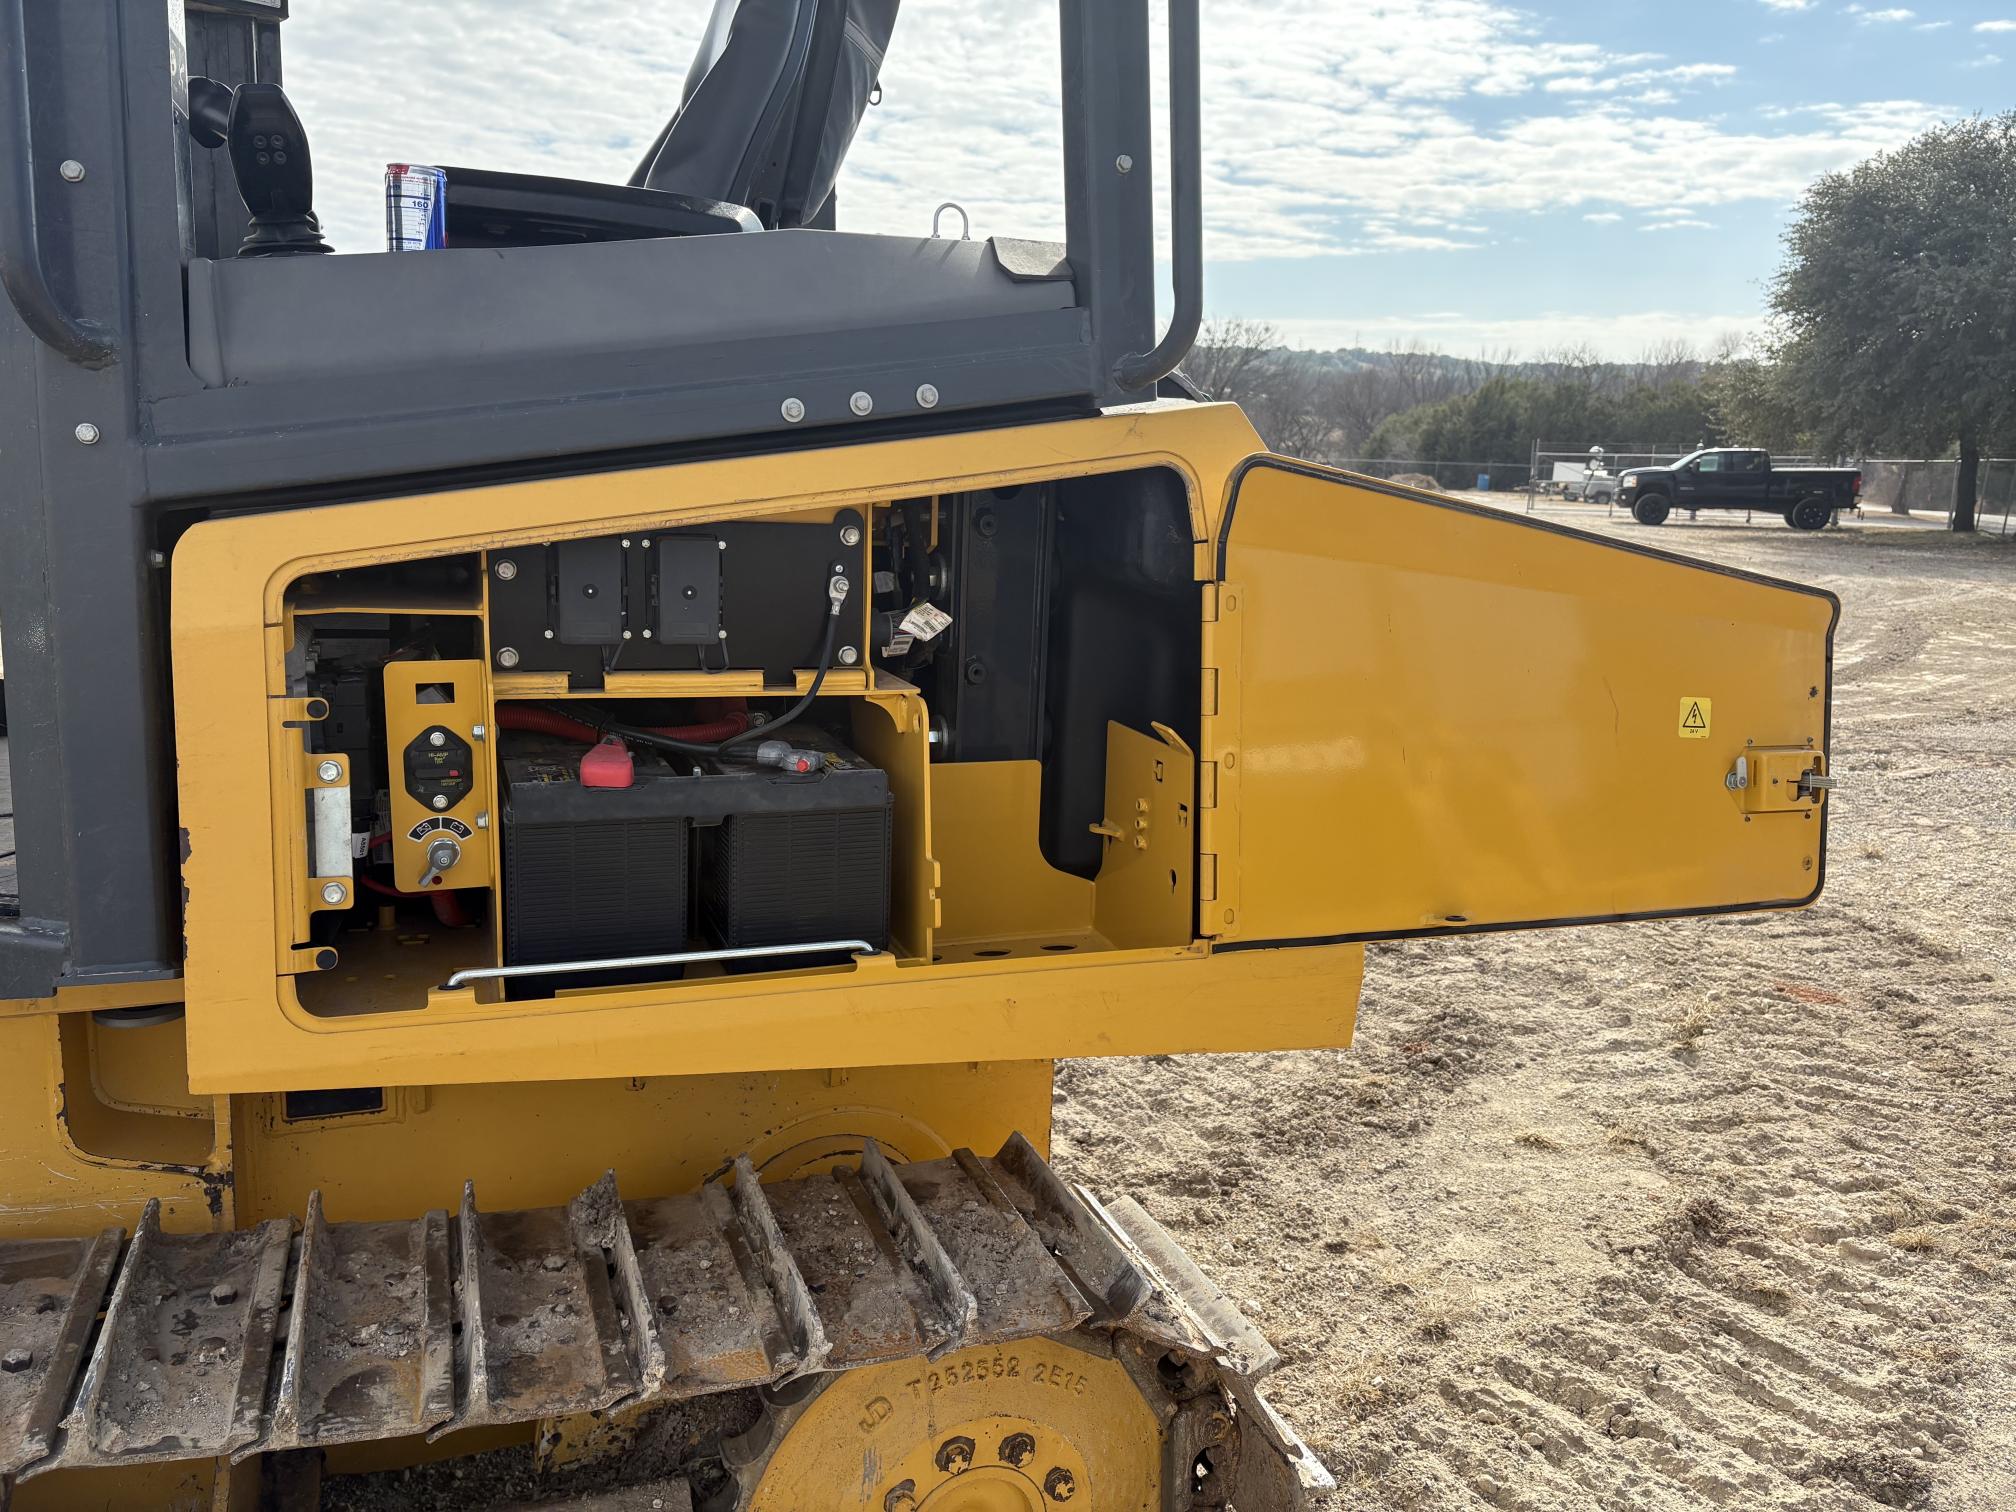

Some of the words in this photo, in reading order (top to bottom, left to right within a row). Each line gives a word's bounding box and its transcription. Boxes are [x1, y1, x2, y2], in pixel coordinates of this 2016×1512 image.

[412, 200, 428, 208] 160
[905, 1356, 1020, 1400] T252552
[1031, 1363, 1088, 1397] 2E15
